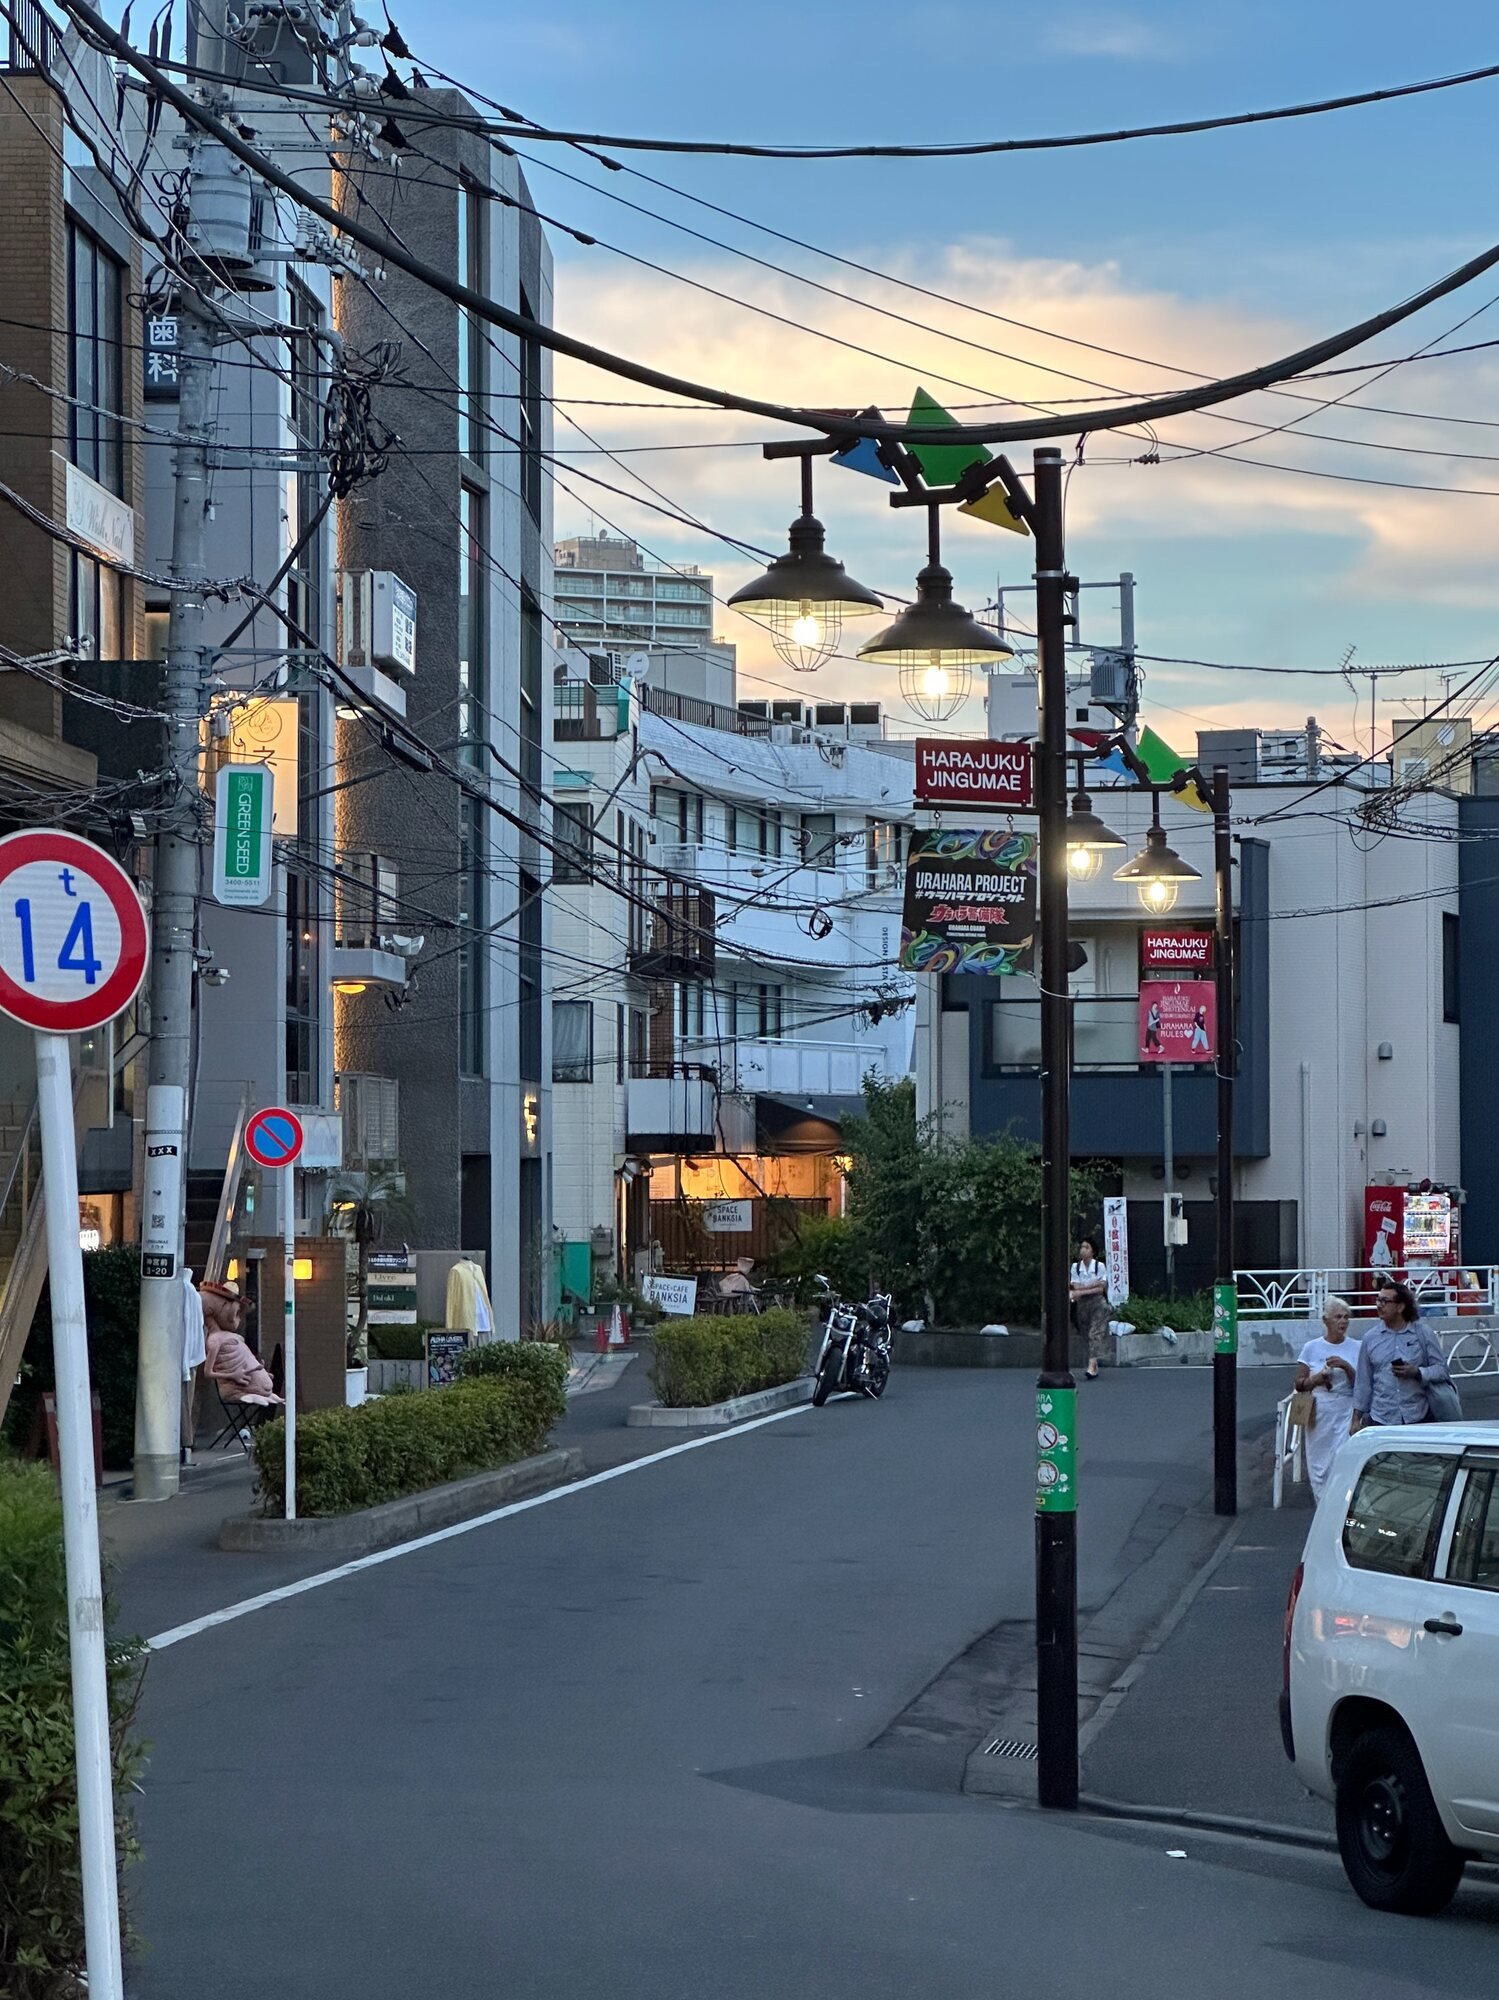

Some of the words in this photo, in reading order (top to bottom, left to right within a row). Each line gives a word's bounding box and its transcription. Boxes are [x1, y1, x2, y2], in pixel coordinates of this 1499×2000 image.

[148, 315, 179, 383] 歯科
[922, 750, 1025, 771] HARAJUKU
[926, 770, 1022, 791] JINGUMAE
[237, 793, 252, 838] GREEN
[236, 840, 251, 874] SEED
[58, 867, 77, 897] t
[225, 878, 260, 886] 3400-5511
[915, 871, 972, 891] URAHARA
[975, 874, 1027, 893] PROJECT
[914, 890, 1026, 902] #ウラハラプロジェクト
[15, 898, 102, 985] 14
[1147, 937, 1208, 948] HARAJUKU
[1150, 949, 1206, 960] JINGUMAE
[1160, 1022, 1194, 1030] URAHARA
[1160, 1030, 1184, 1038] RULES
[717, 1205, 738, 1214] SPACE
[712, 1214, 743, 1223] BANKSIA
[650, 1291, 688, 1303] BANKSIA
